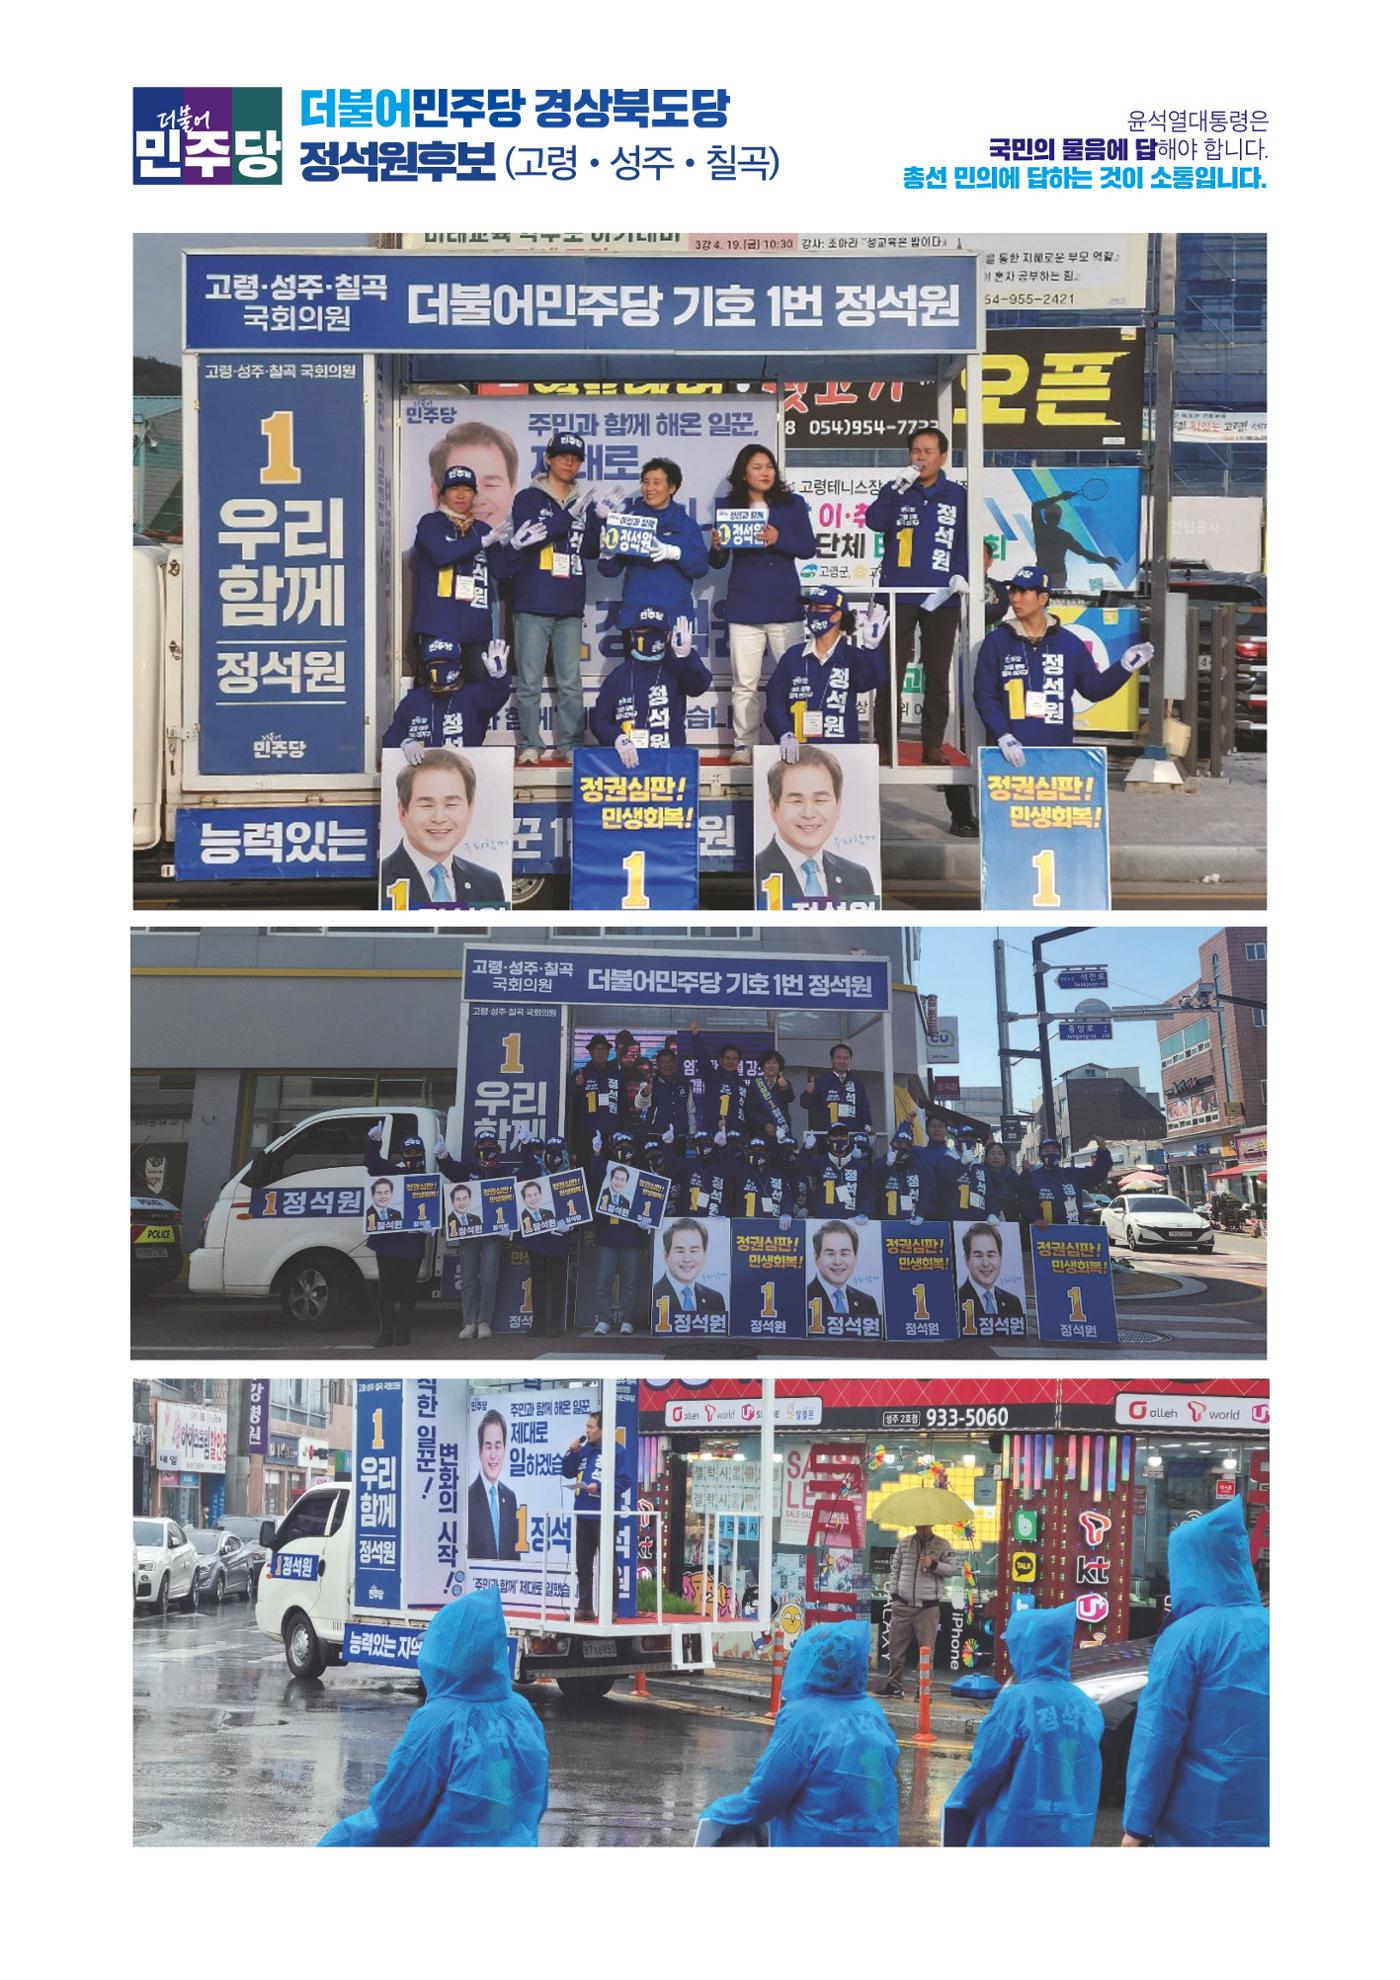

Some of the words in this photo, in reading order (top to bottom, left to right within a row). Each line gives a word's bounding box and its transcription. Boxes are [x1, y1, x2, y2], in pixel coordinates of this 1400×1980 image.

[764, 238, 793, 249] 10:30
[1023, 252, 1065, 264] 지혜로운
[1068, 252, 1089, 262] 부모
[205, 273, 388, 301] 고령·성주·칠곡
[243, 305, 351, 332] 국회의원
[408, 283, 664, 327] 더불어민주당
[673, 284, 757, 327] 기호
[767, 284, 824, 327] 1번
[836, 284, 960, 327] 정석원
[205, 364, 296, 379] 고령·성주·칠곡
[300, 364, 356, 379] 국회의원
[406, 406, 457, 425] 민주당
[528, 412, 599, 437] 주민과
[603, 412, 650, 437] 함께
[656, 412, 701, 437] 해온
[708, 412, 759, 437] 일꾼,
[260, 410, 302, 485] 1
[218, 497, 344, 560] 우리
[932, 503, 957, 572] 정석원
[896, 528, 913, 567] 1
[218, 564, 345, 627] 함께
[216, 650, 346, 694] 정석원
[824, 666, 850, 738] 정석원
[1004, 678, 1026, 720] 1
[1041, 653, 1065, 725] 정석원
[790, 700, 808, 743] 1
[253, 740, 307, 758] 민주당
[580, 776, 687, 803] 정권심판!
[987, 775, 1095, 802] 정권심판!
[601, 806, 694, 831] 민생회복!
[1009, 806, 1103, 829] 민생회복!
[200, 820, 369, 865] 능력있는
[621, 851, 650, 910] 1
[1031, 849, 1062, 908] 1
[492, 976, 553, 994] 국회의원
[588, 968, 722, 996] 더불어민주당
[727, 971, 770, 997] 기호
[774, 973, 804, 997] 1번
[808, 975, 873, 999] 정석원
[930, 1033, 949, 1044] CU
[500, 1032, 525, 1074] 1
[474, 1080, 548, 1117] 우리
[263, 1191, 278, 1216] 1
[282, 1190, 362, 1216] 정석원
[146, 1229, 171, 1240] POLICE
[736, 1235, 799, 1253] 정권심판!
[885, 1238, 944, 1254] 정권심판!
[748, 1254, 803, 1270] 민생회복!
[1036, 1240, 1102, 1257] 정권심판!
[898, 1256, 949, 1272] 민생회복!
[1051, 1259, 1108, 1275] 민생회복!
[760, 1281, 777, 1319] 1
[912, 1283, 931, 1320] 1
[1066, 1285, 1088, 1323] 1
[655, 1295, 673, 1333] 1
[674, 1313, 727, 1334] 정석원
[750, 1319, 787, 1334] 정석원
[808, 1296, 825, 1334] 1
[826, 1315, 881, 1337] 정석원
[961, 1299, 978, 1336] 1
[979, 1316, 1025, 1336] 정석원
[905, 1321, 941, 1336] 정석원
[1060, 1323, 1098, 1338] 정석원
[510, 1402, 535, 1418] 주민과
[536, 1402, 553, 1417] 함께
[554, 1400, 572, 1415] 해온
[716, 1412, 735, 1420] world
[926, 1406, 1009, 1427] 933-5060
[1149, 1408, 1178, 1418] olleh
[1209, 1409, 1240, 1420] world
[372, 1408, 385, 1449] 1
[510, 1421, 549, 1445] 제대로
[360, 1455, 397, 1490] 우리
[438, 1443, 460, 1514] 변화의
[360, 1492, 397, 1528] 함께
[514, 1504, 530, 1553] 1
[359, 1539, 396, 1565] 정석원
[281, 1555, 313, 1578] 정석원
[1076, 1555, 1110, 1584] kt
[349, 1631, 397, 1658] 능력있는
[950, 1612, 964, 1671] iPhone
